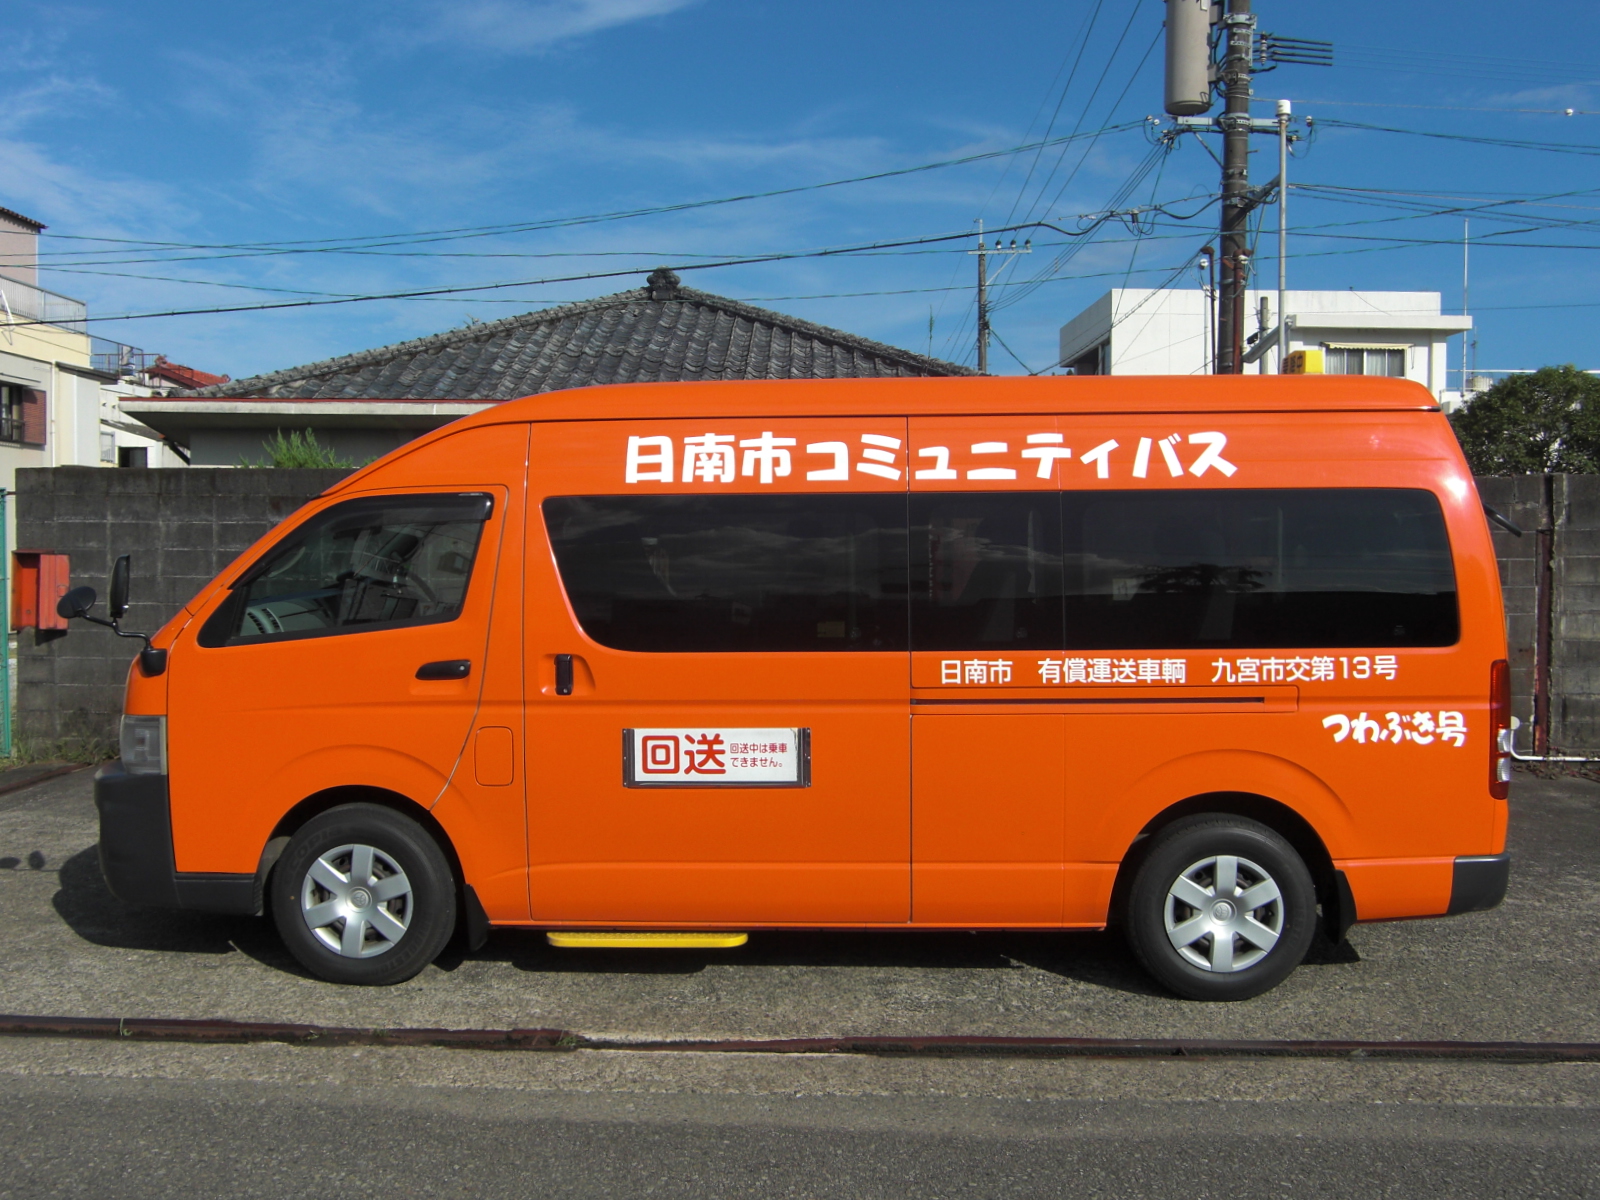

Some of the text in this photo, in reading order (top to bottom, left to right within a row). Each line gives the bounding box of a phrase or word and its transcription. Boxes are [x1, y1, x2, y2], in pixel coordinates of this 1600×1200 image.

[625, 431, 1239, 484] 日南市コミュニティバス
[940, 658, 1013, 684] 日南市
[1211, 655, 1398, 682] 九宮市交第13号
[1322, 711, 1468, 748] つわぶき号
[641, 733, 727, 775] 回送
[729, 742, 788, 754] 回送中は乗車
[730, 756, 783, 768] できません。
